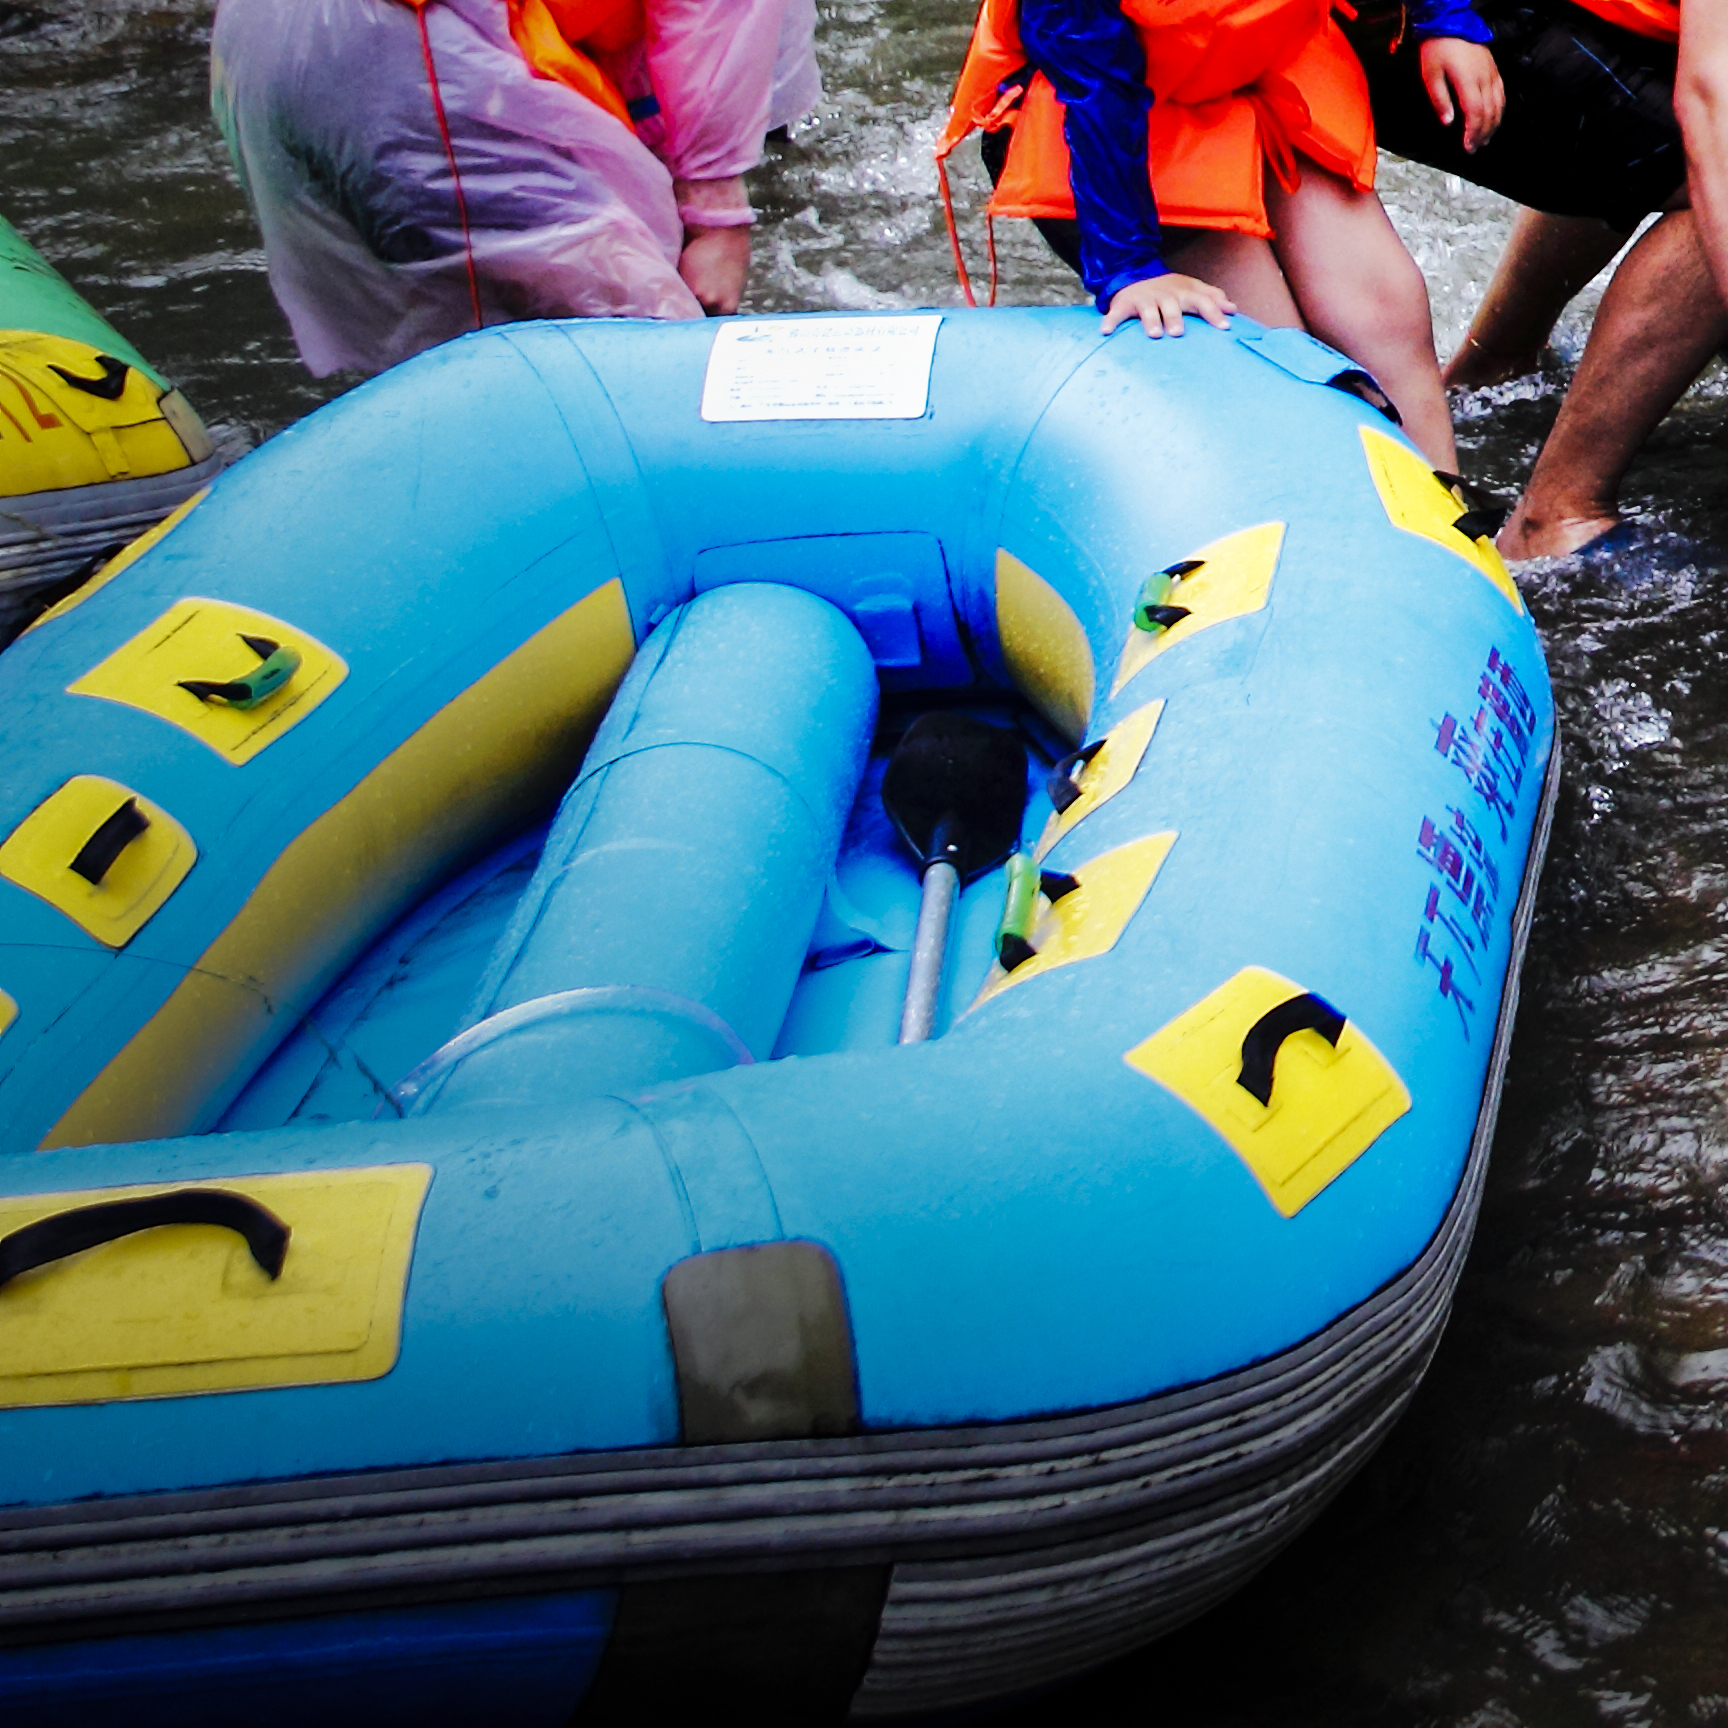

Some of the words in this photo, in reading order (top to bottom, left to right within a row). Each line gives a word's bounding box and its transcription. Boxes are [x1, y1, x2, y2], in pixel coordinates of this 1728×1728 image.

[1430, 645, 1536, 845] 爽在豫西
[1414, 804, 1499, 1045] 天下漂流
